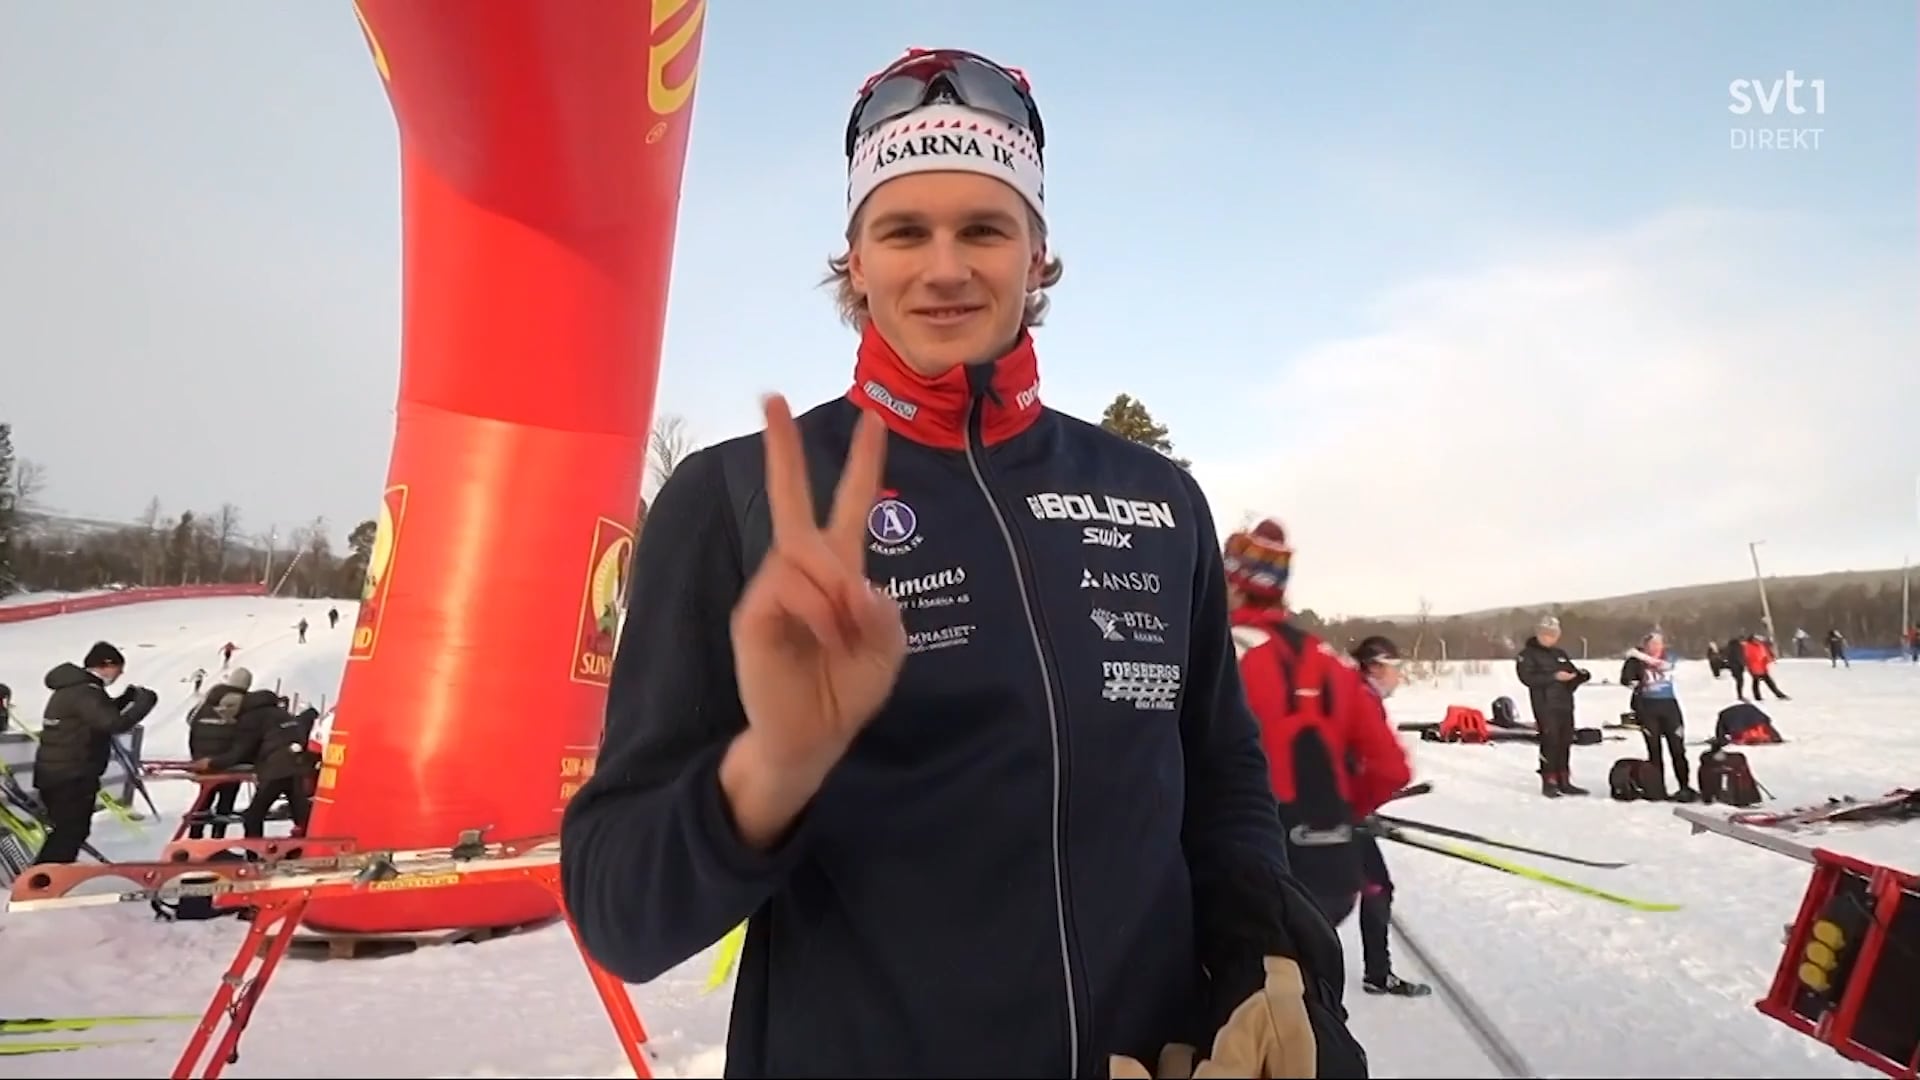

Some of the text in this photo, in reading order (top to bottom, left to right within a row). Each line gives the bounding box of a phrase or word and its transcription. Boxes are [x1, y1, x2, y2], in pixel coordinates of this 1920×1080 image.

[873, 134, 1017, 174] ÅSARNA IK
[1038, 493, 1176, 528] BOLIDEN
[1102, 661, 1180, 680] FORSBERGS
